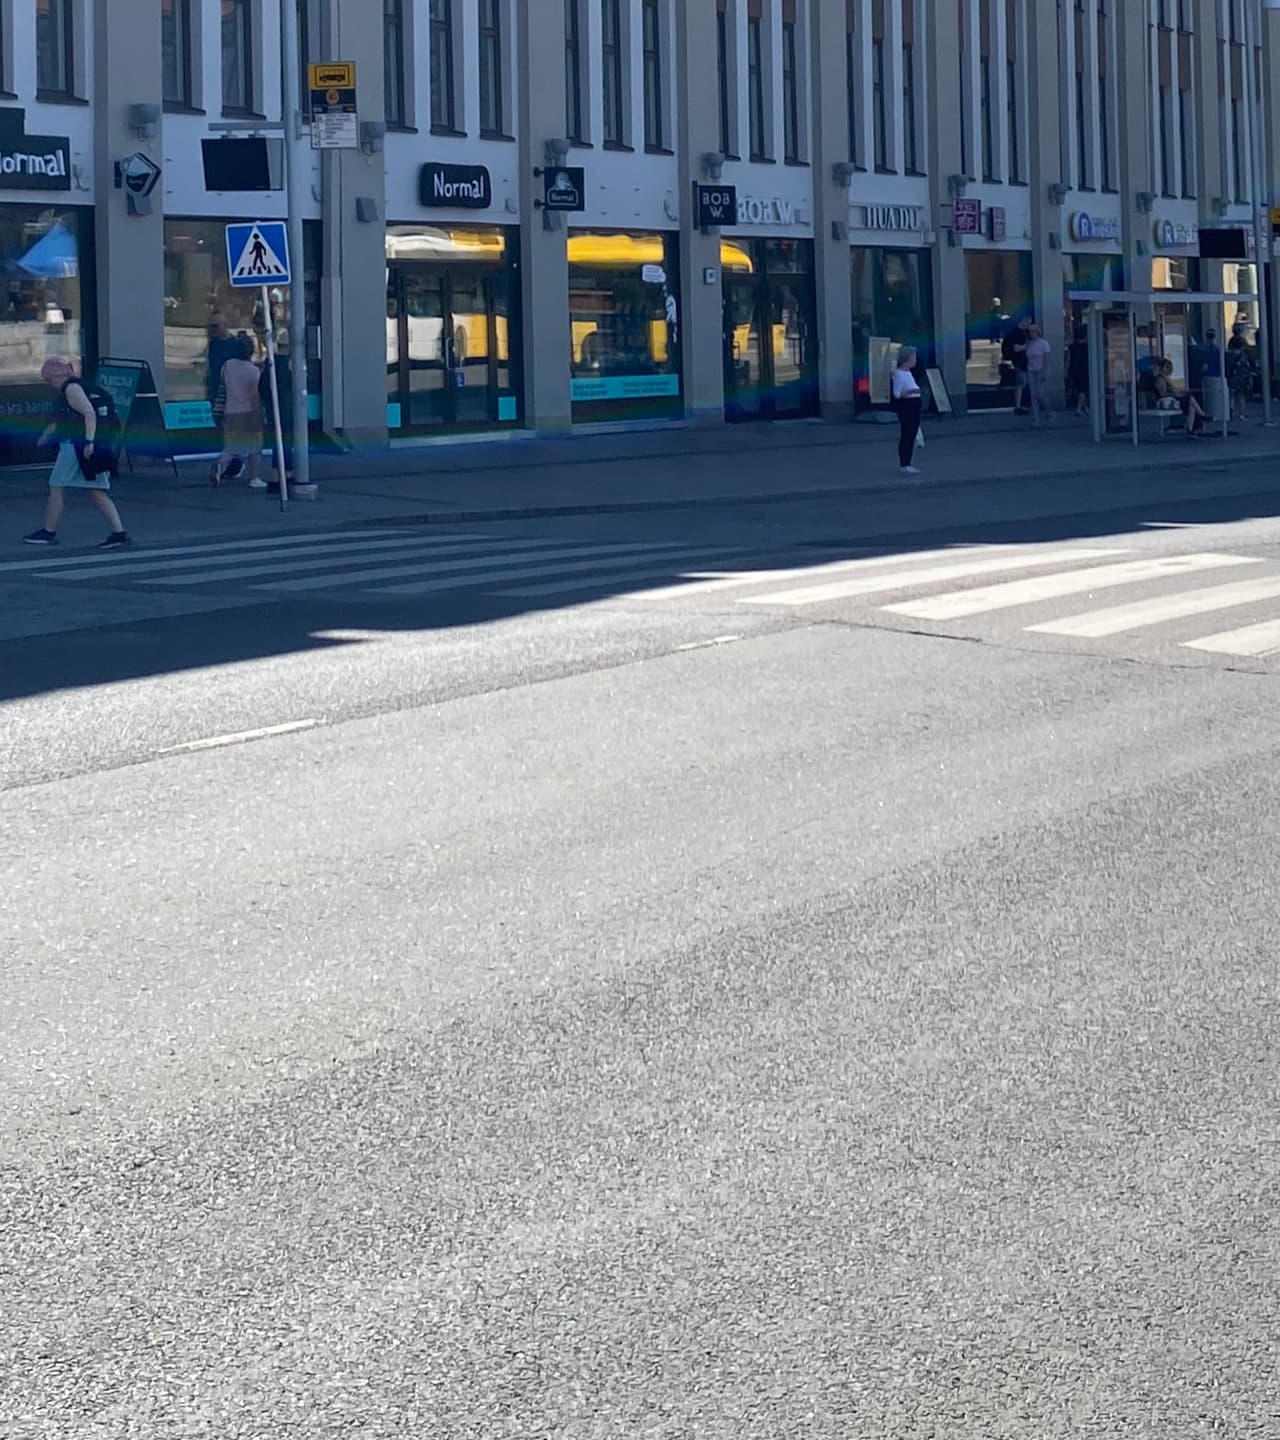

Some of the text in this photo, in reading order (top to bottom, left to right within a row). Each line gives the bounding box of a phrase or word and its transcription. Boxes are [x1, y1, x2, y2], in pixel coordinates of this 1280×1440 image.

[433, 170, 484, 199] Normal
[702, 192, 730, 206] BOB
[709, 205, 725, 219] W.
